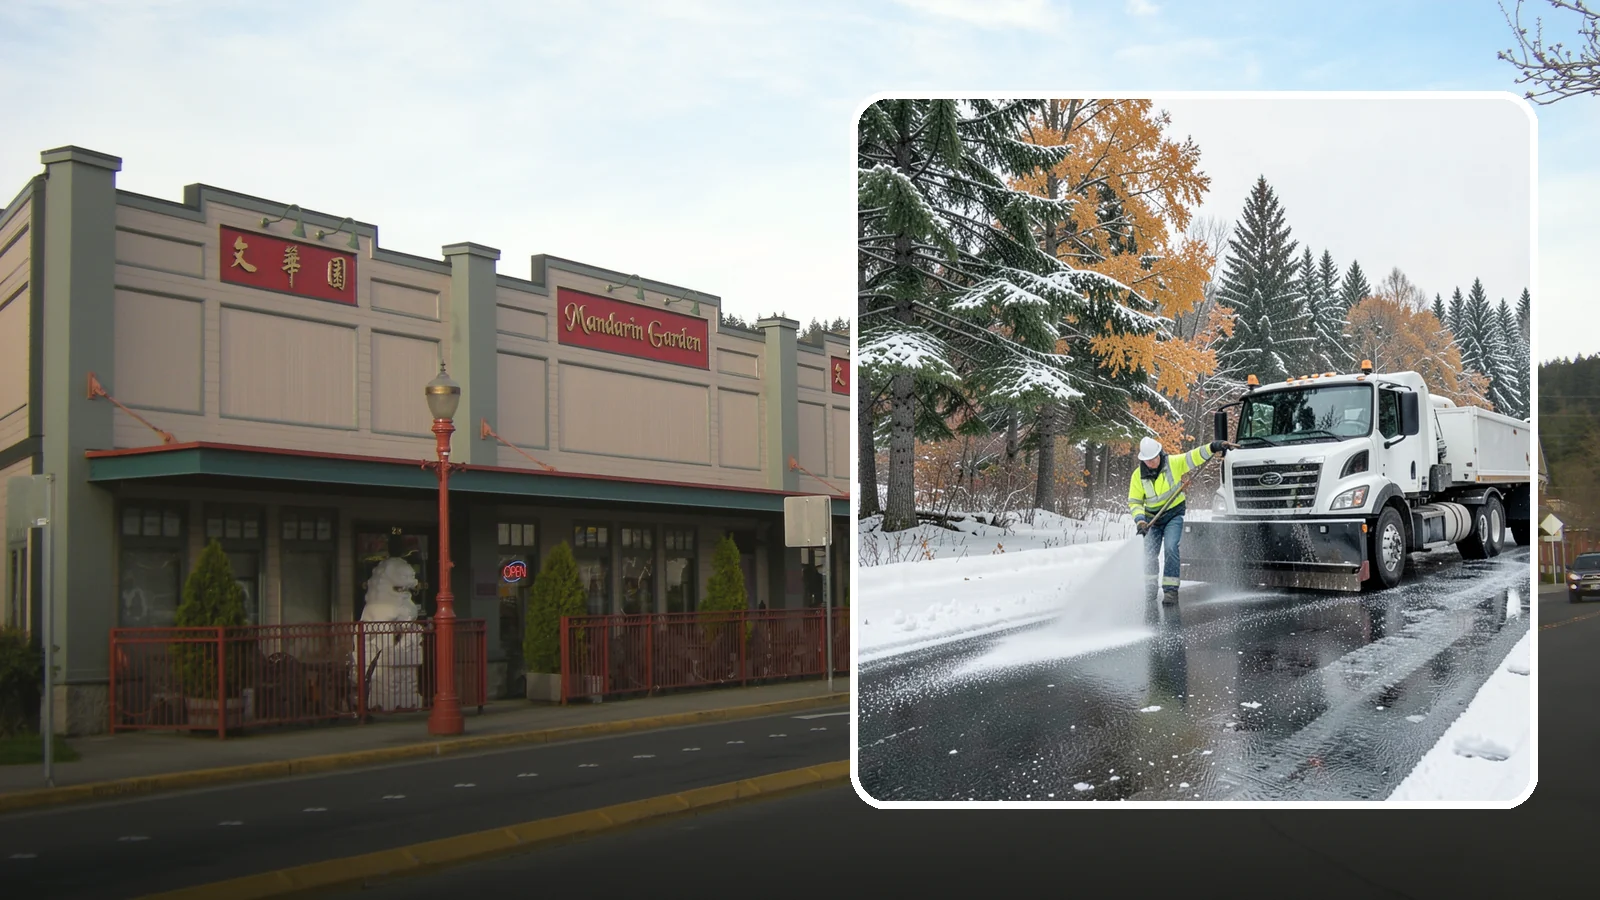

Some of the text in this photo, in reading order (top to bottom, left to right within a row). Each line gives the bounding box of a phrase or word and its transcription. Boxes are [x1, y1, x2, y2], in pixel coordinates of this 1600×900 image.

[564, 302, 702, 352] Mandarin Garden
[834, 363, 847, 386] 文
[503, 565, 527, 578] OPEN
